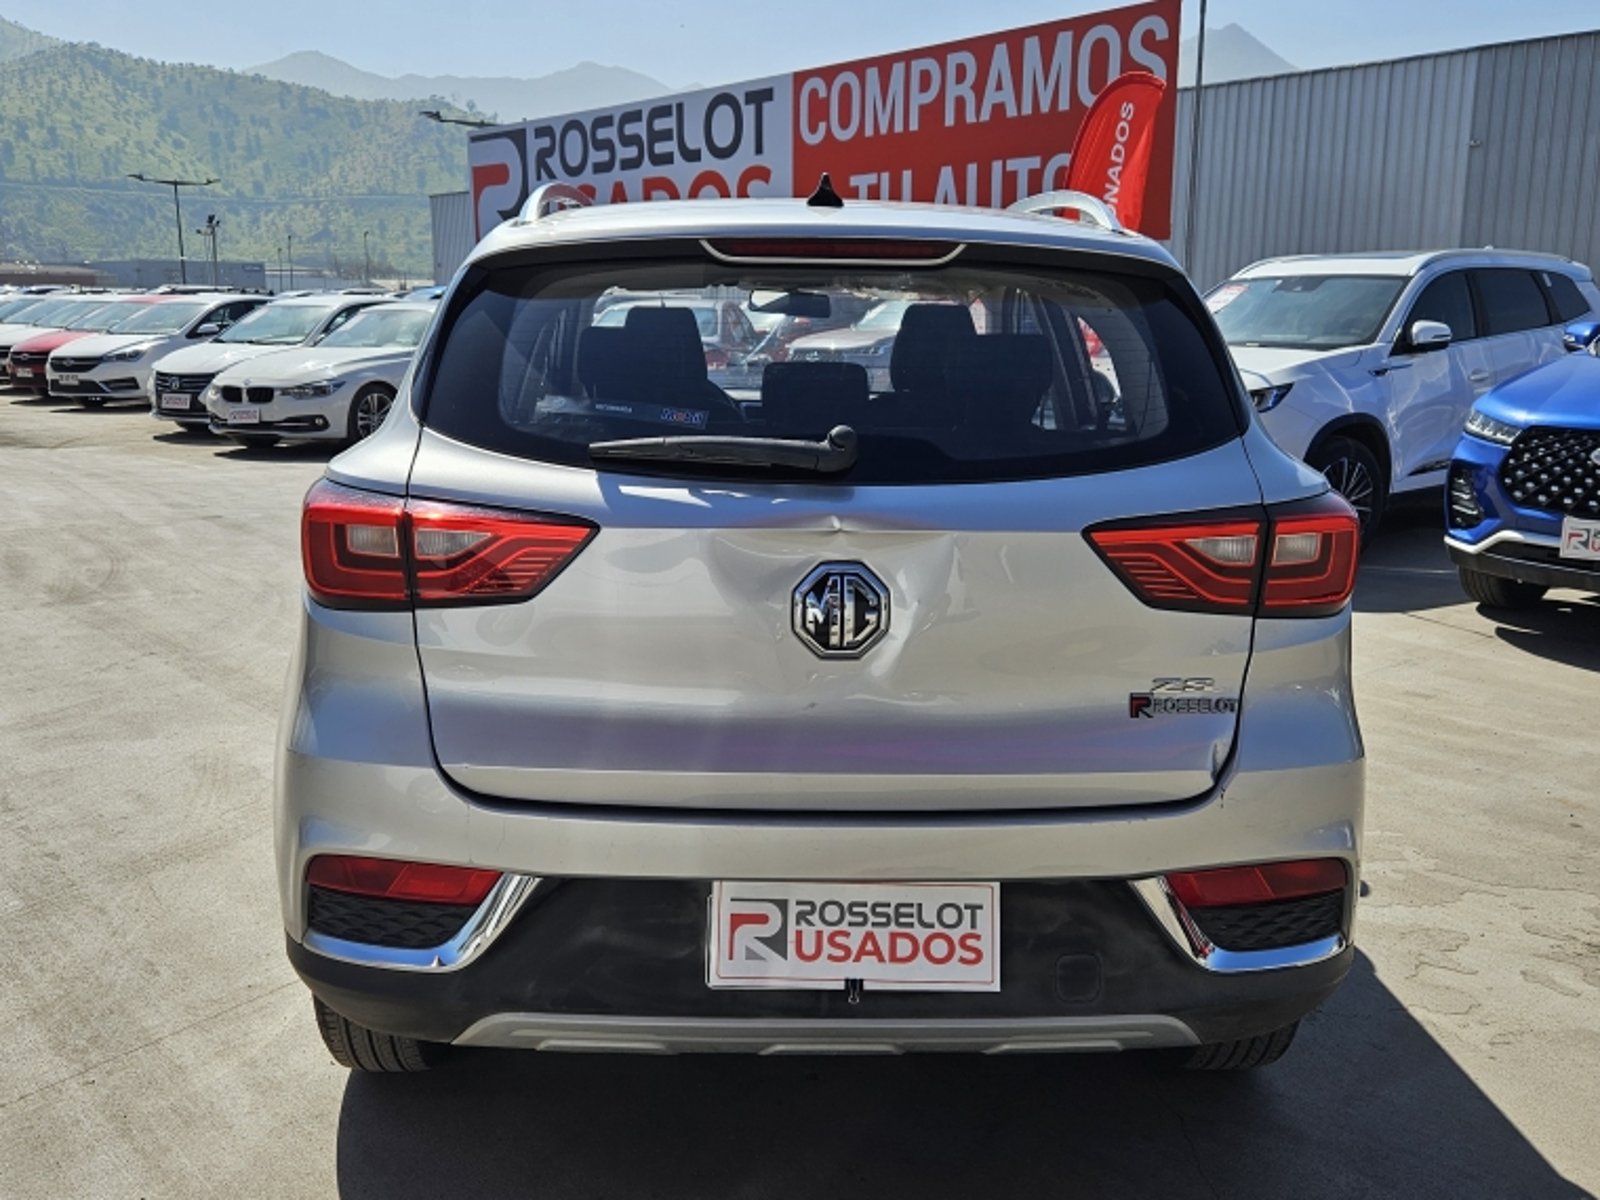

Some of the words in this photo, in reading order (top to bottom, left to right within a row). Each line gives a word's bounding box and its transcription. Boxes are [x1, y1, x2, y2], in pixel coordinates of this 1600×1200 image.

[799, 14, 1169, 146] COMPRAMOS
[533, 87, 774, 182] ROSSELOT
[795, 899, 984, 929] ROSSELOT
[794, 929, 984, 966] USADOS
